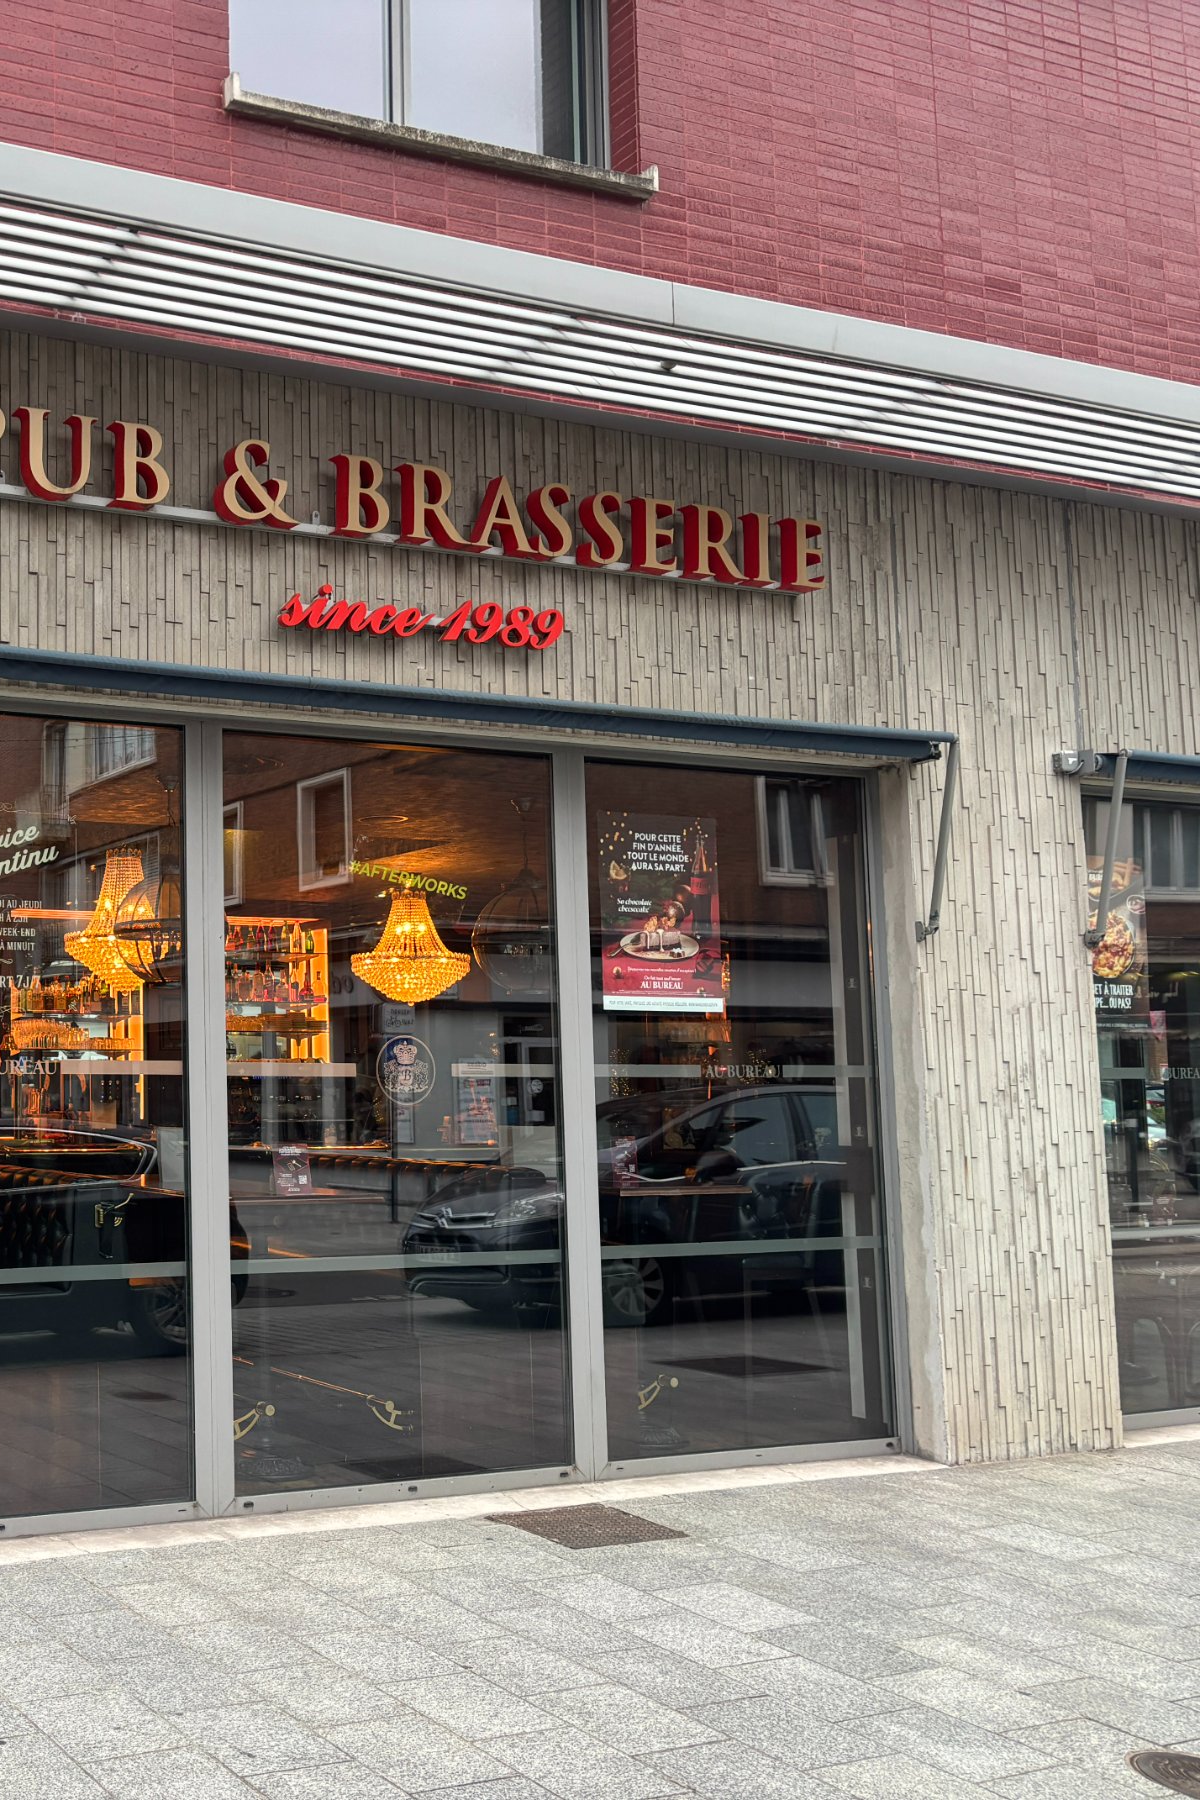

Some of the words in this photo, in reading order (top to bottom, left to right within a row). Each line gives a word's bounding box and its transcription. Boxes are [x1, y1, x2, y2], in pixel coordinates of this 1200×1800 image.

[214, 439, 301, 529] &
[328, 453, 828, 594] BRASSERIE
[277, 584, 435, 637] since
[438, 599, 564, 650] 1989
[634, 833, 657, 842] POUR
[658, 834, 681, 843] CETTE
[632, 842, 646, 851] FIN
[647, 842, 684, 854] D'ANNÉE,
[627, 851, 648, 860] TOUT
[649, 852, 658, 861] LE
[659, 854, 689, 863] MONDE
[631, 861, 653, 871] AURA
[654, 863, 664, 871] SA
[665, 864, 686, 872] PART.
[349, 860, 467, 900] #AFTERWORKS
[6, 899, 17, 909] AU
[19, 900, 42, 910] JEUDI
[6, 941, 36, 951] MINUIT
[640, 980, 651, 989] AU
[653, 980, 683, 990] BUREAU
[1110, 983, 1134, 996] TRAITER
[1109, 998, 1117, 1009] OU
